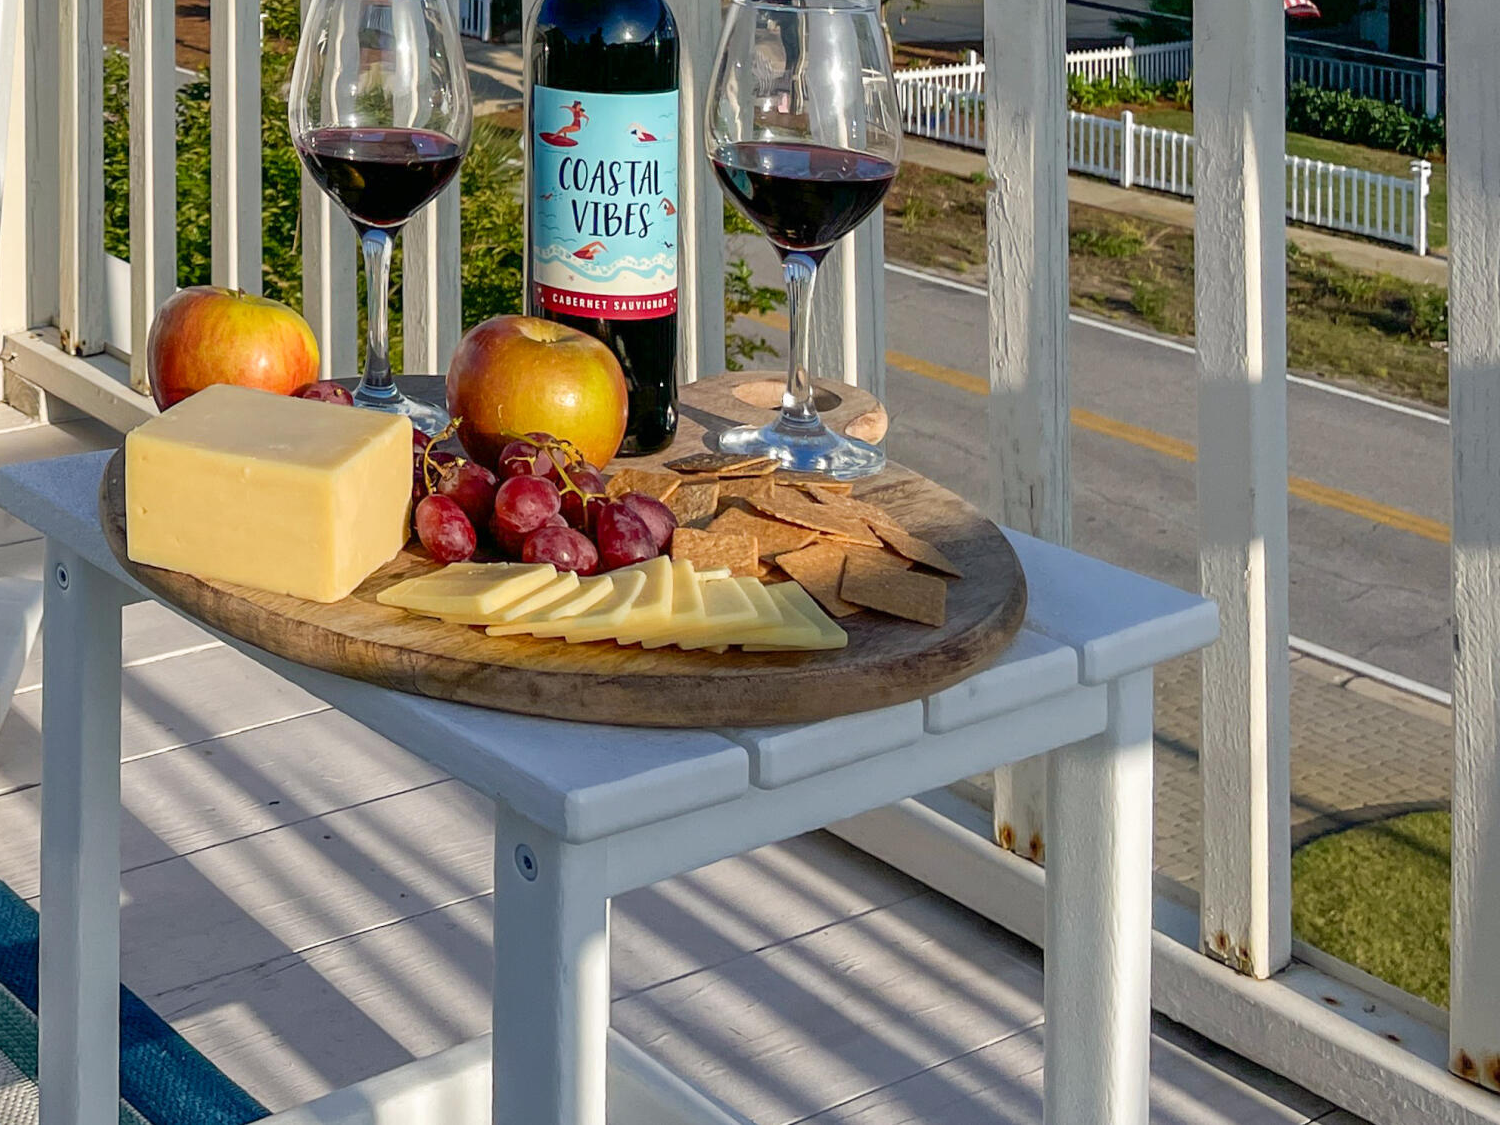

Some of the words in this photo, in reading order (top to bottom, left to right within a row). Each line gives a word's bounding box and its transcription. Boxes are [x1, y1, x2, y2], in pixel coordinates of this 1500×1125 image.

[558, 156, 663, 197] COASTAL
[572, 199, 654, 238] VIBES
[552, 293, 608, 310] CABERNET
[613, 297, 668, 311] SAUVIGNON
